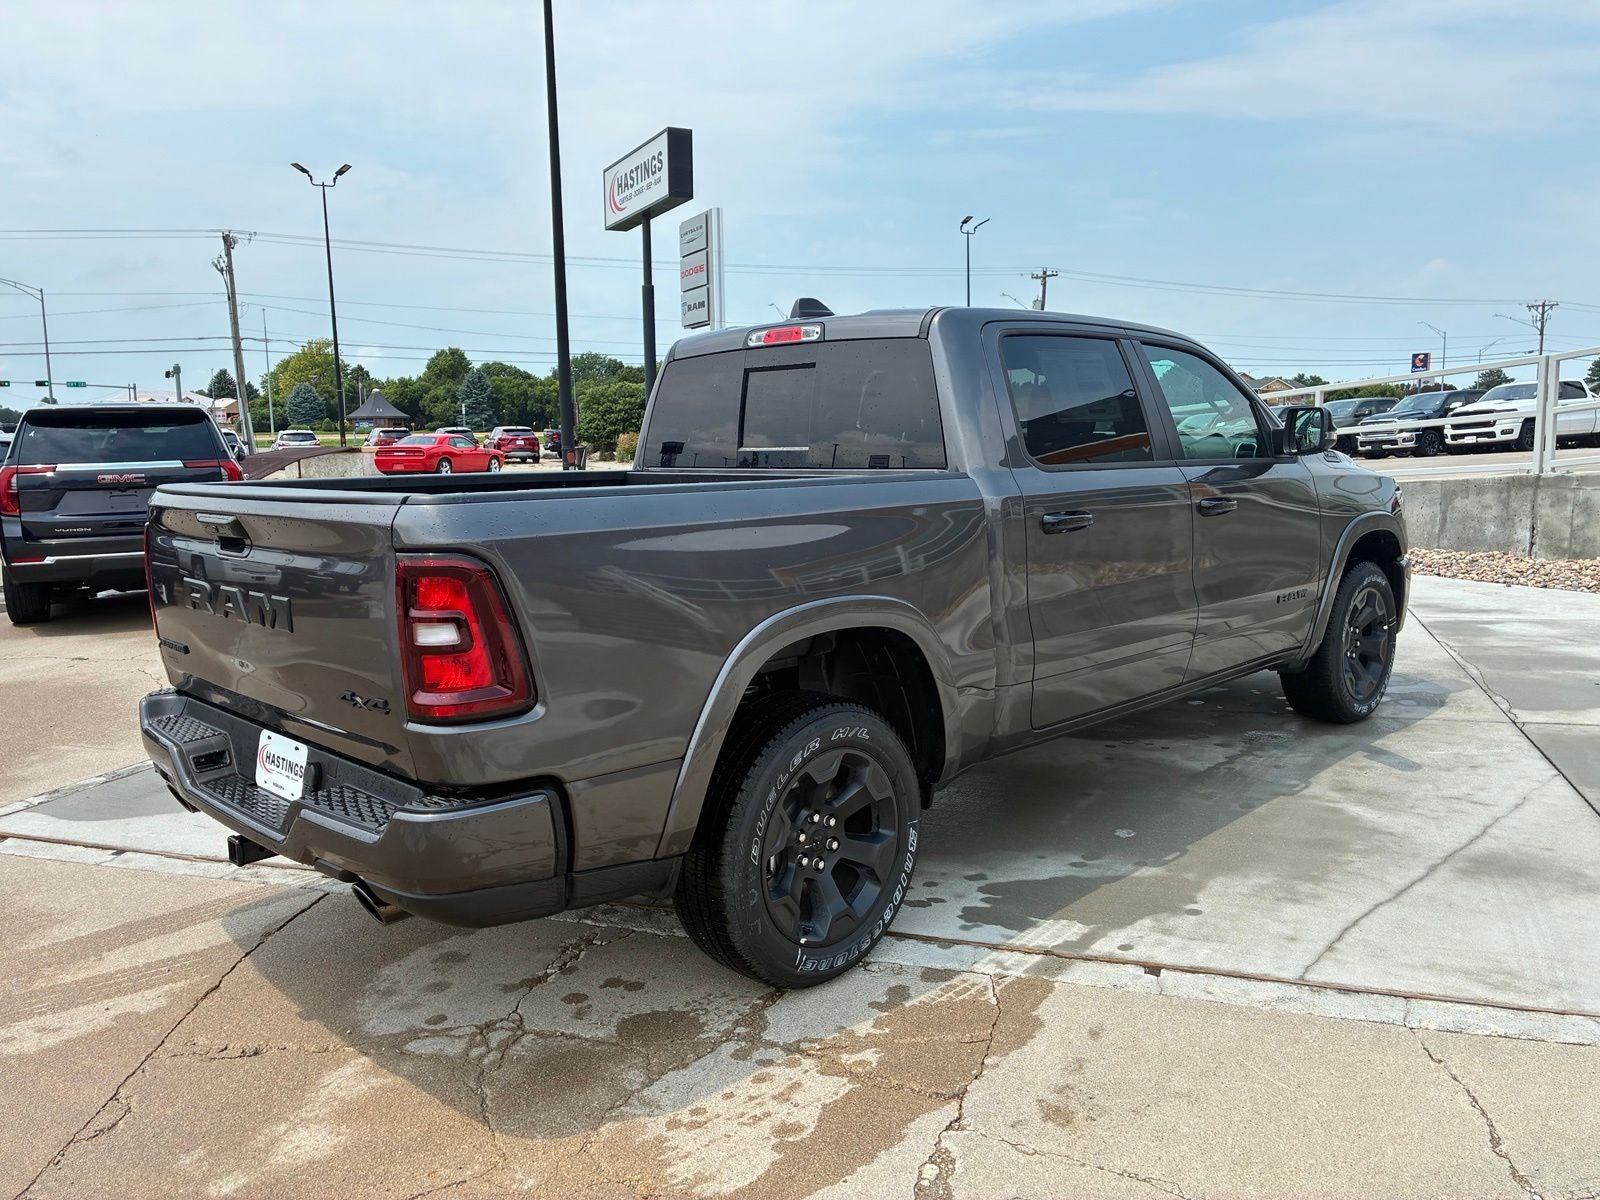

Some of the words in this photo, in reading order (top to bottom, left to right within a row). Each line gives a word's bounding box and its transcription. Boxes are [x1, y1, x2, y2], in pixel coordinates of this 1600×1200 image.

[617, 151, 663, 196] HASTINGS
[681, 225, 703, 238] CHRYSLER
[681, 264, 704, 279] DODGE
[688, 301, 705, 312] RAM
[98, 473, 145, 484] GMC
[183, 576, 294, 633] RAM
[265, 750, 304, 779] HASTINGS
